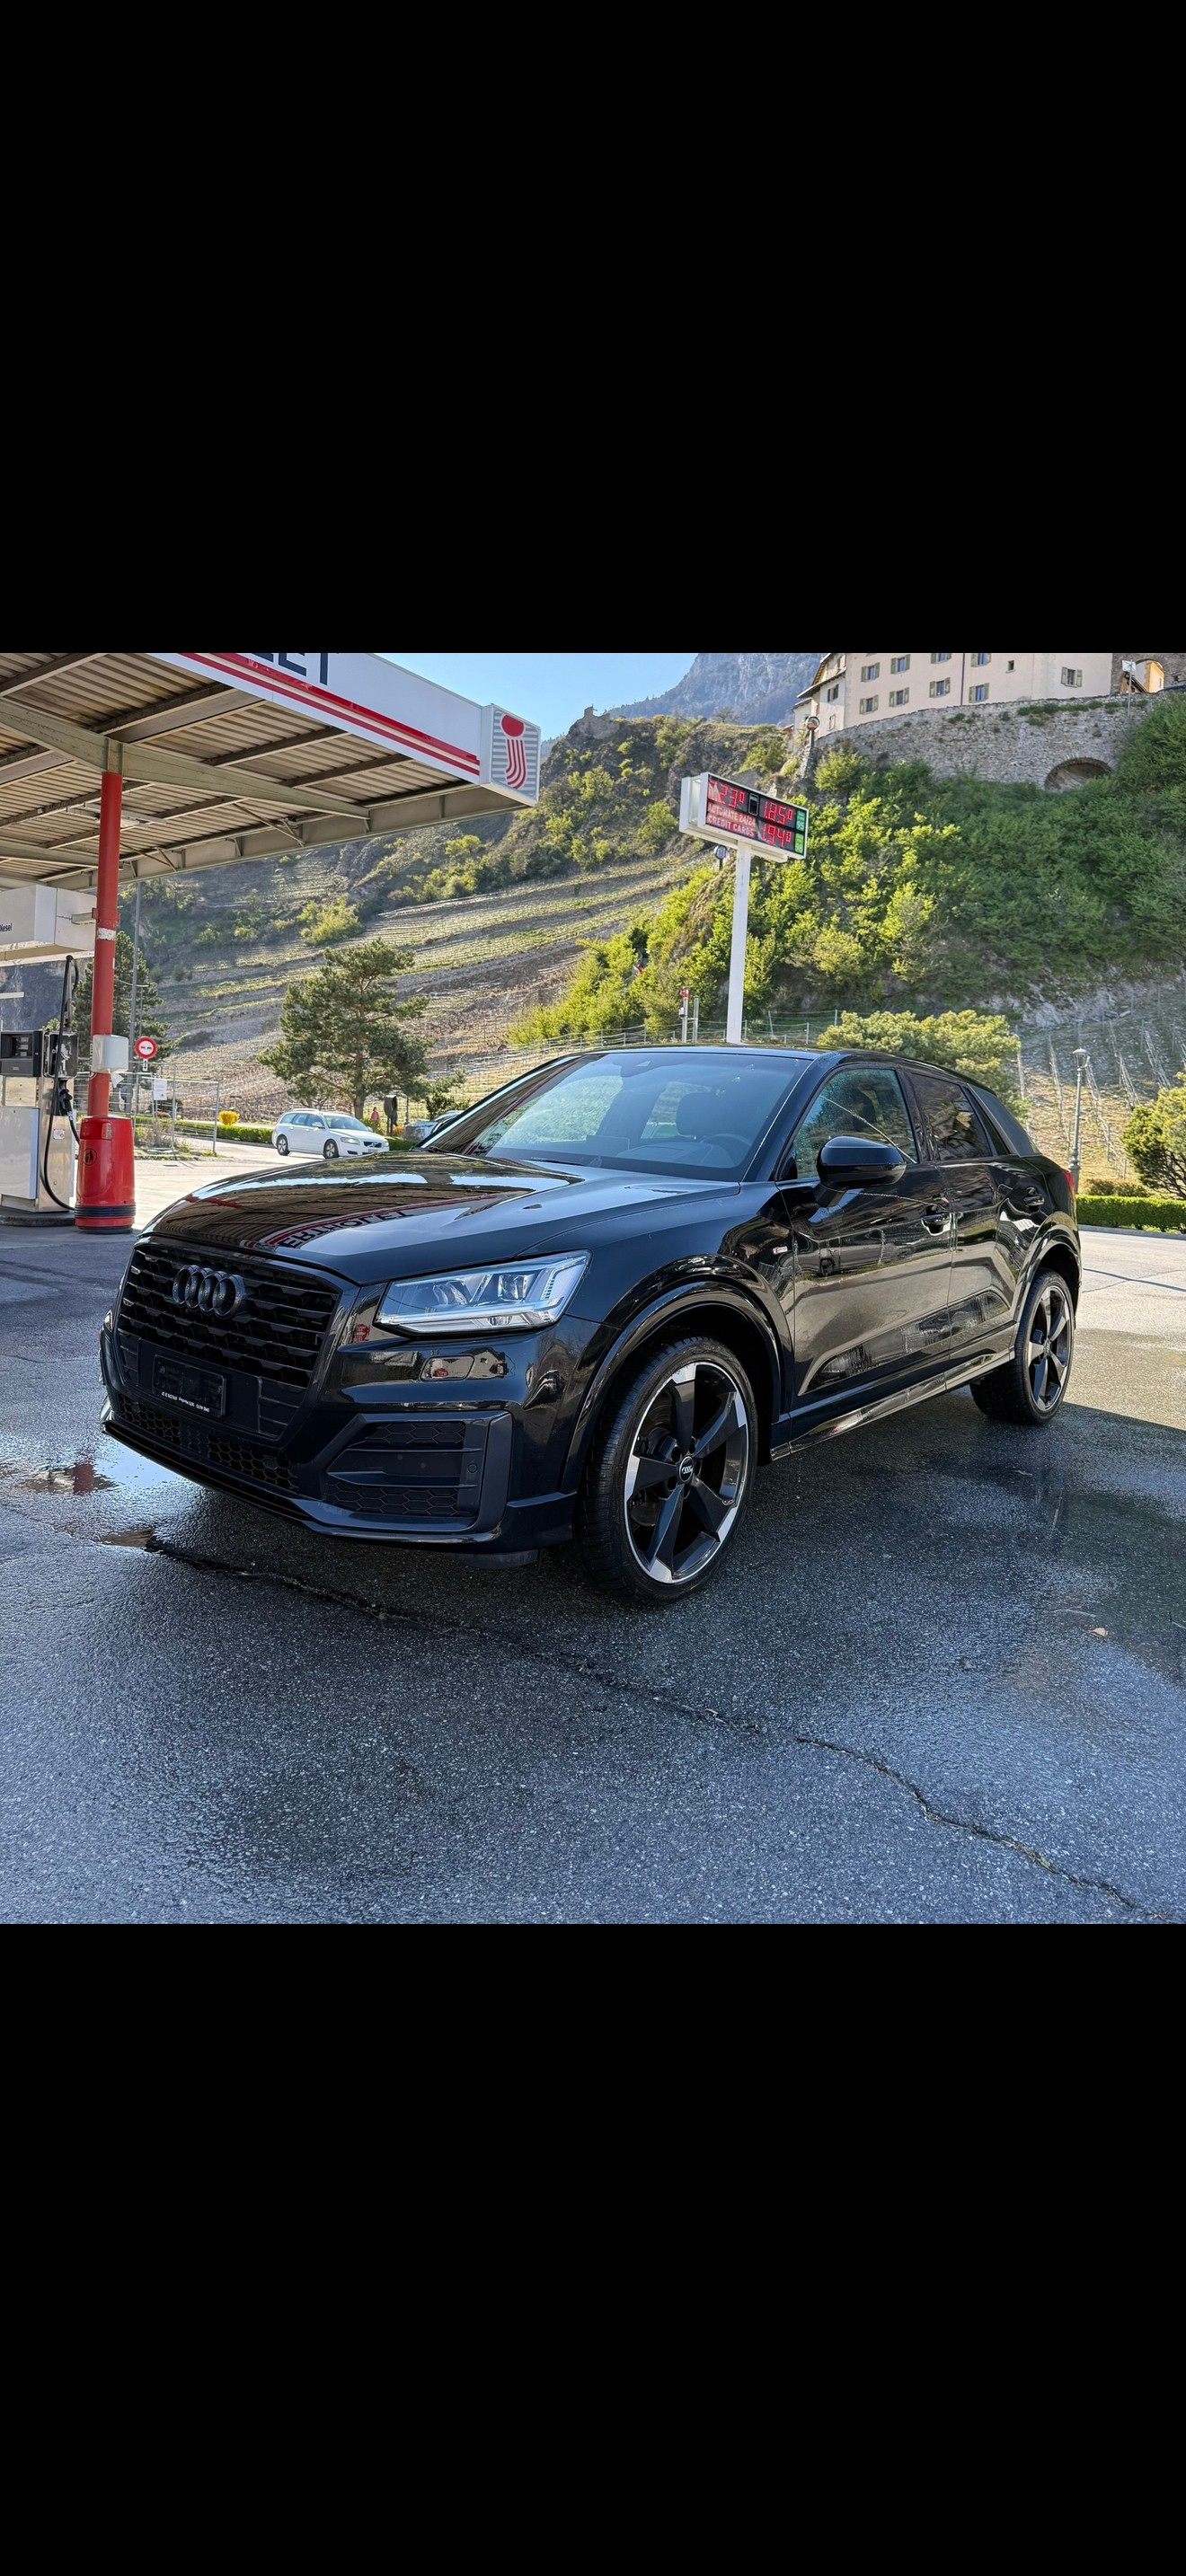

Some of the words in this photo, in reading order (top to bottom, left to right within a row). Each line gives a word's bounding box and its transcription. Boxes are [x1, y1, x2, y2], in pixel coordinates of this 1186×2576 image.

[707, 802, 739, 821] AUTOMATE
[707, 814, 731, 829] CREDIT
[732, 824, 755, 837] CARDS
[796, 820, 805, 831] 95
